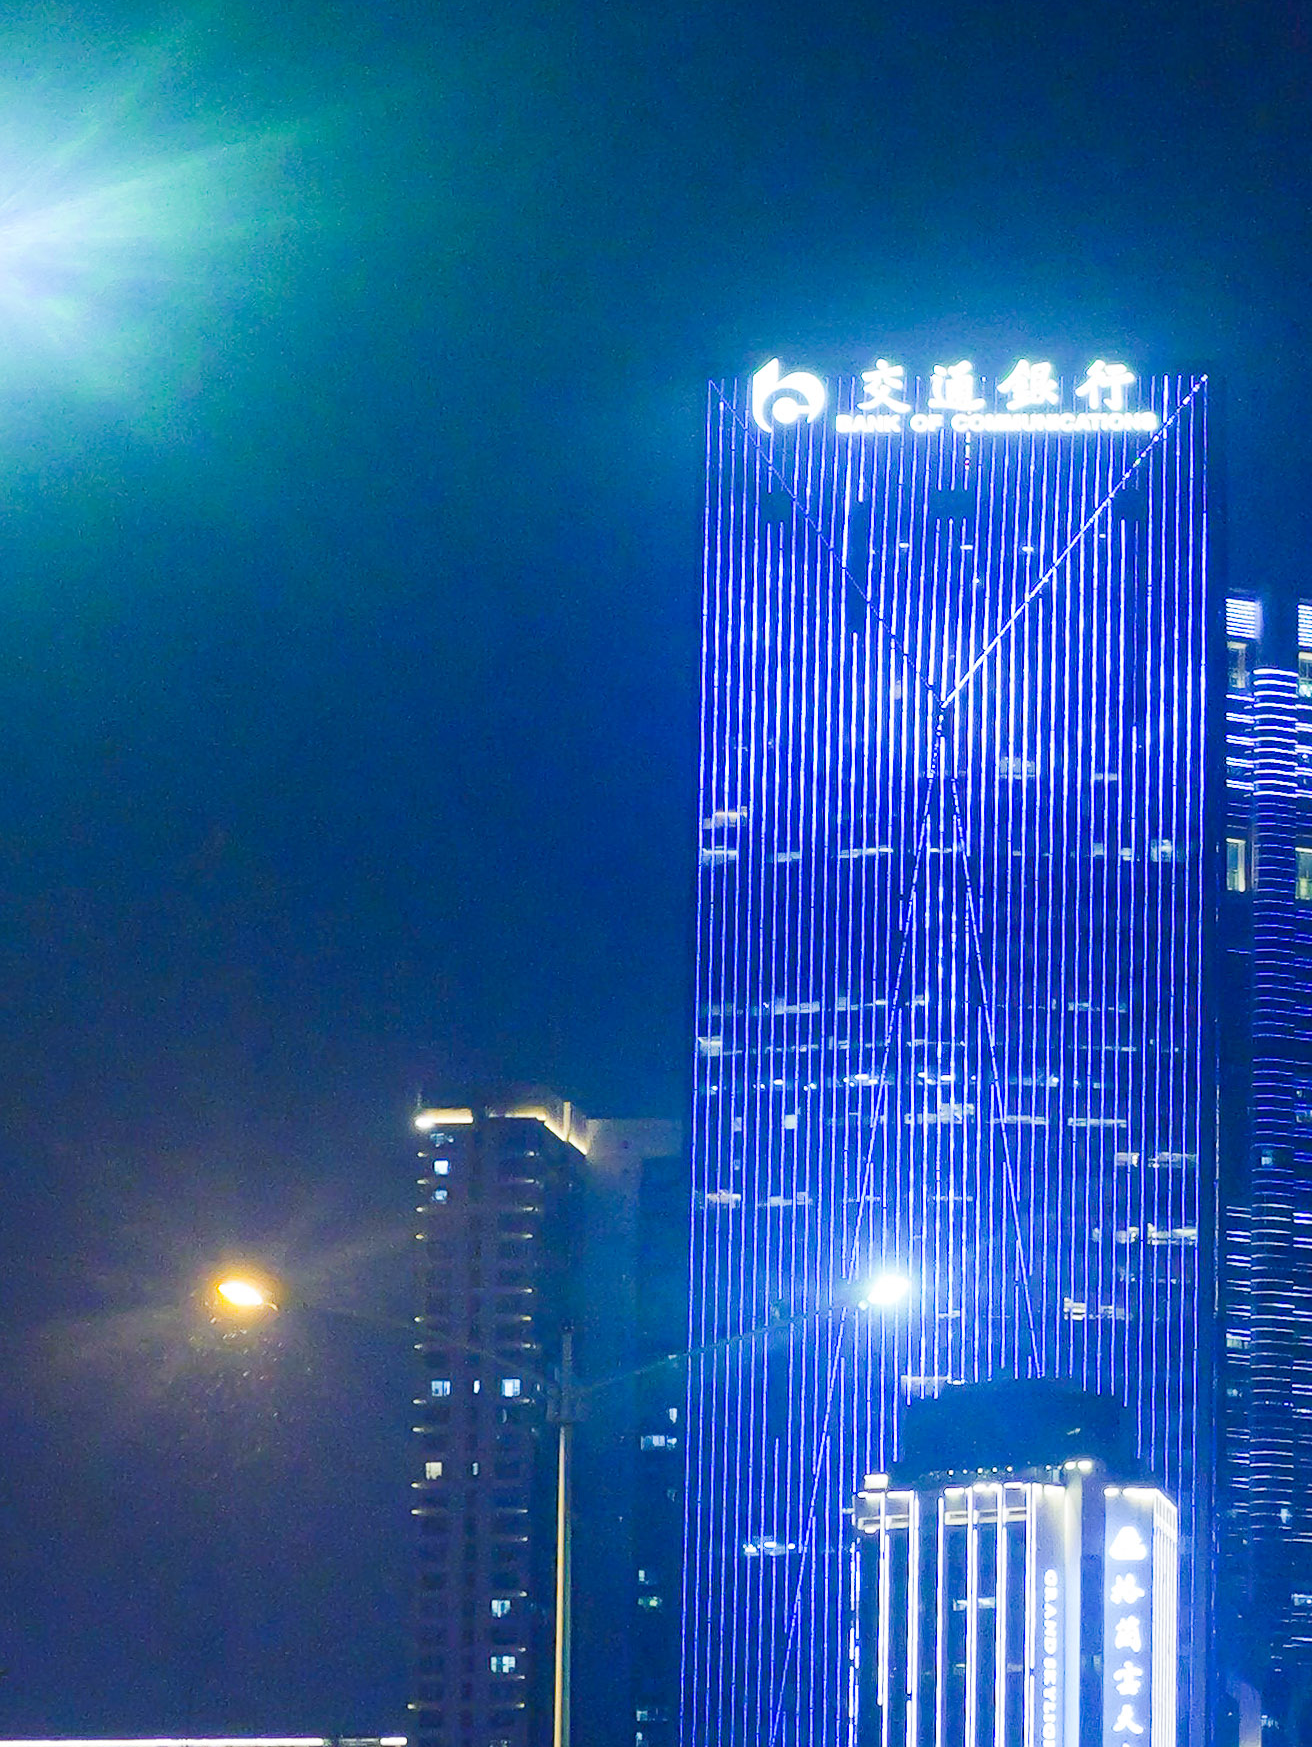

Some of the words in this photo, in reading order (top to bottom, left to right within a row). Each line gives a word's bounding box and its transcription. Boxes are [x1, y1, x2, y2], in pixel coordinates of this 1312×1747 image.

[835, 413, 902, 434] BANK
[909, 413, 944, 433] OF
[950, 411, 1158, 433] COMMUNICATIONS
[1043, 1569, 1059, 1655] GRAND
